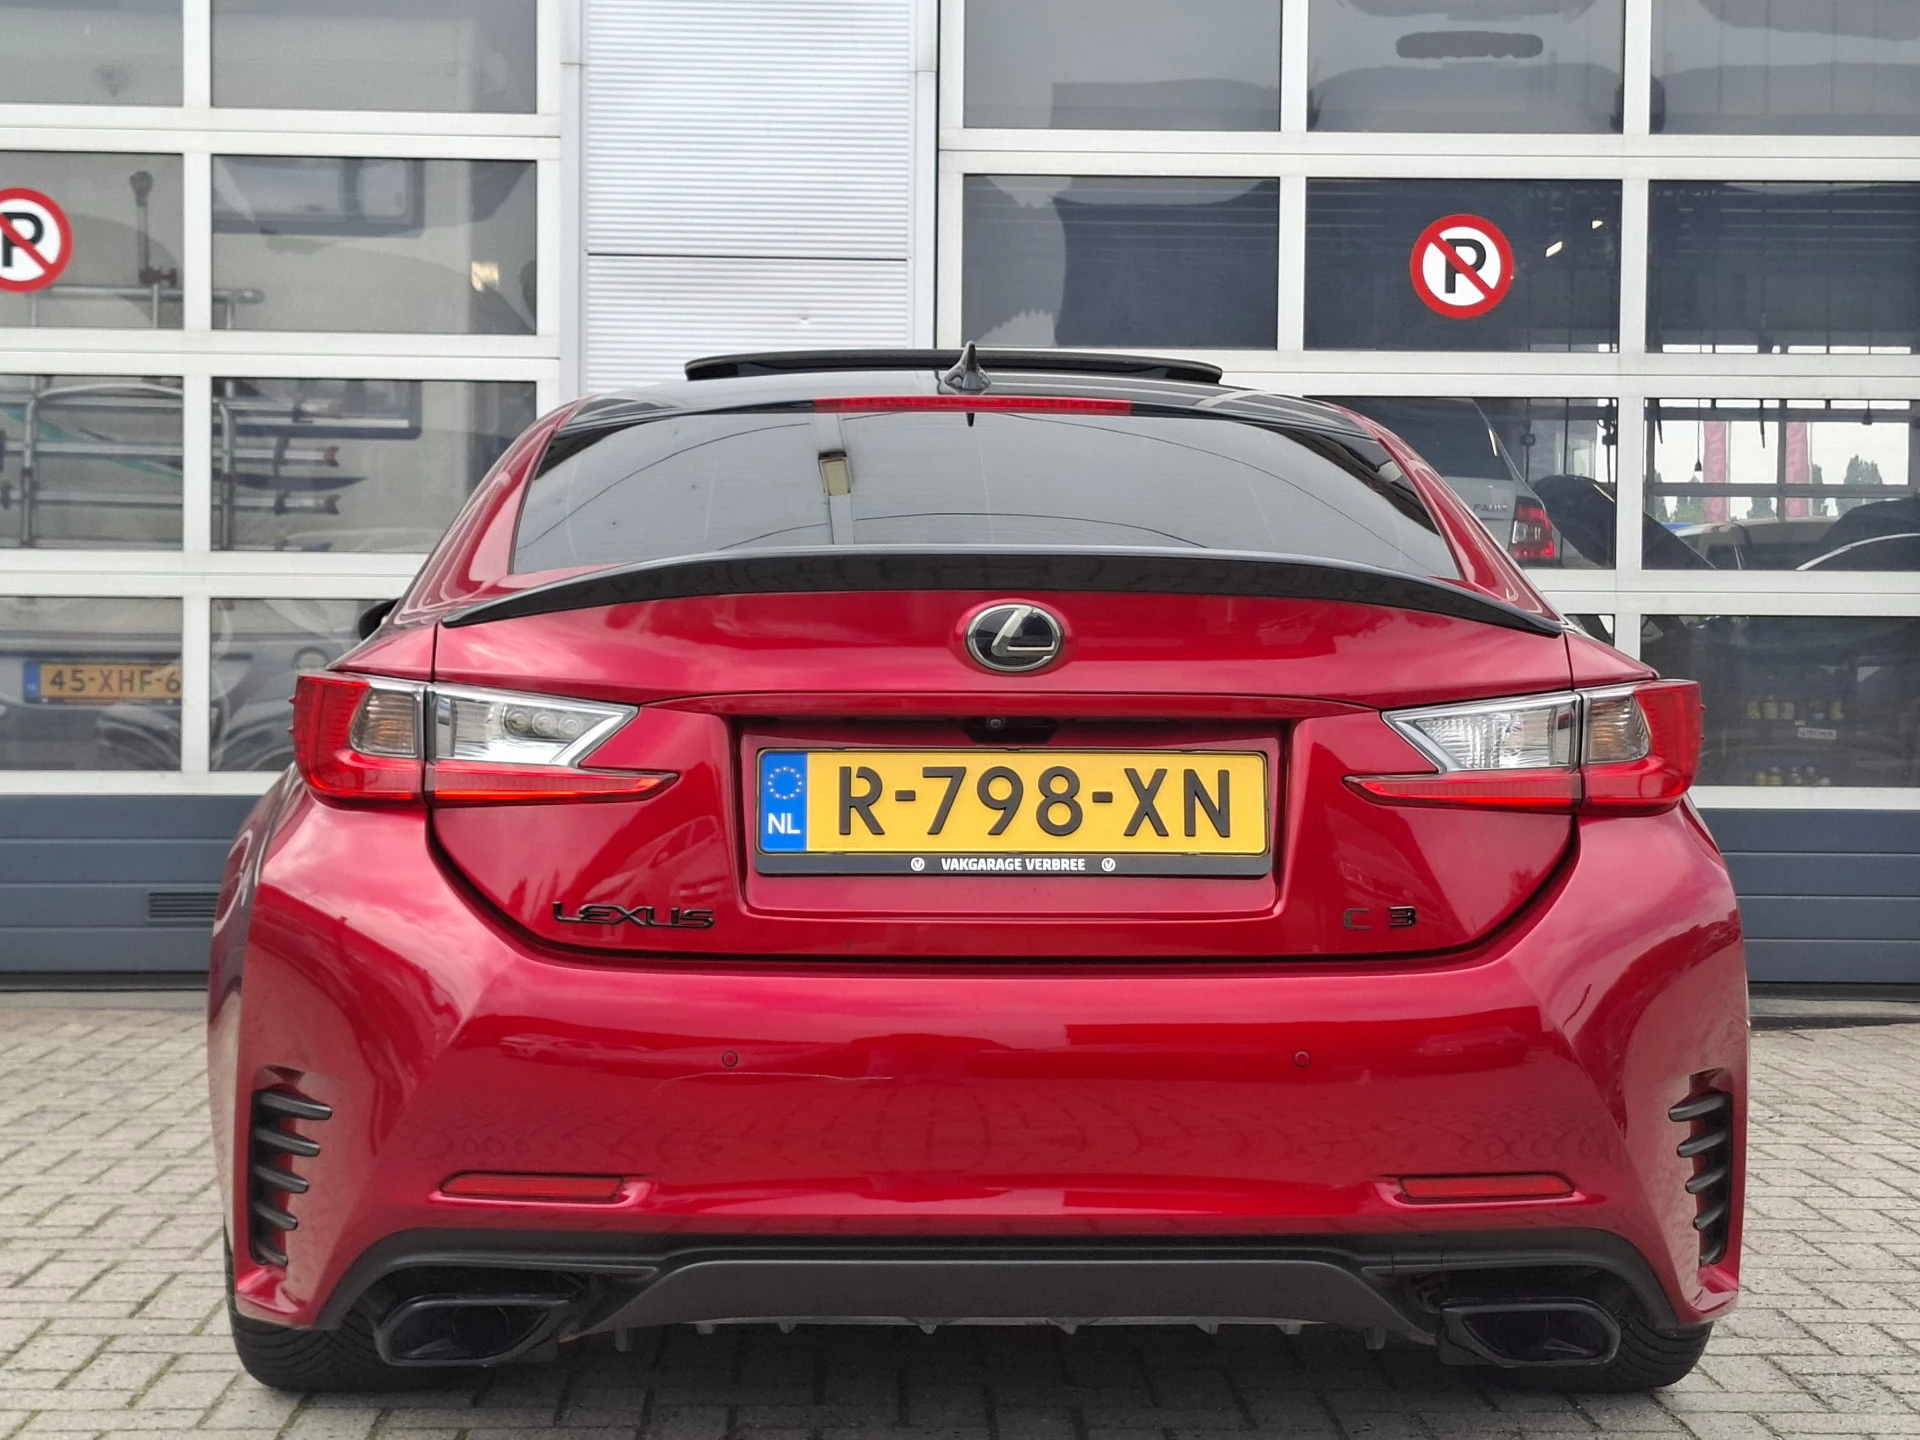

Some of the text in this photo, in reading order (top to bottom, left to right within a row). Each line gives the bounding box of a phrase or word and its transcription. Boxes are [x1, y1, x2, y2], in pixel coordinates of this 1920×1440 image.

[2, 212, 44, 267] P
[1444, 238, 1487, 294] P
[838, 765, 1230, 838] R-798-XN
[767, 812, 800, 835] NL
[941, 858, 1022, 871] VAKGARAGE
[1025, 858, 1086, 871] VERBREE
[553, 901, 715, 929] LEXUS
